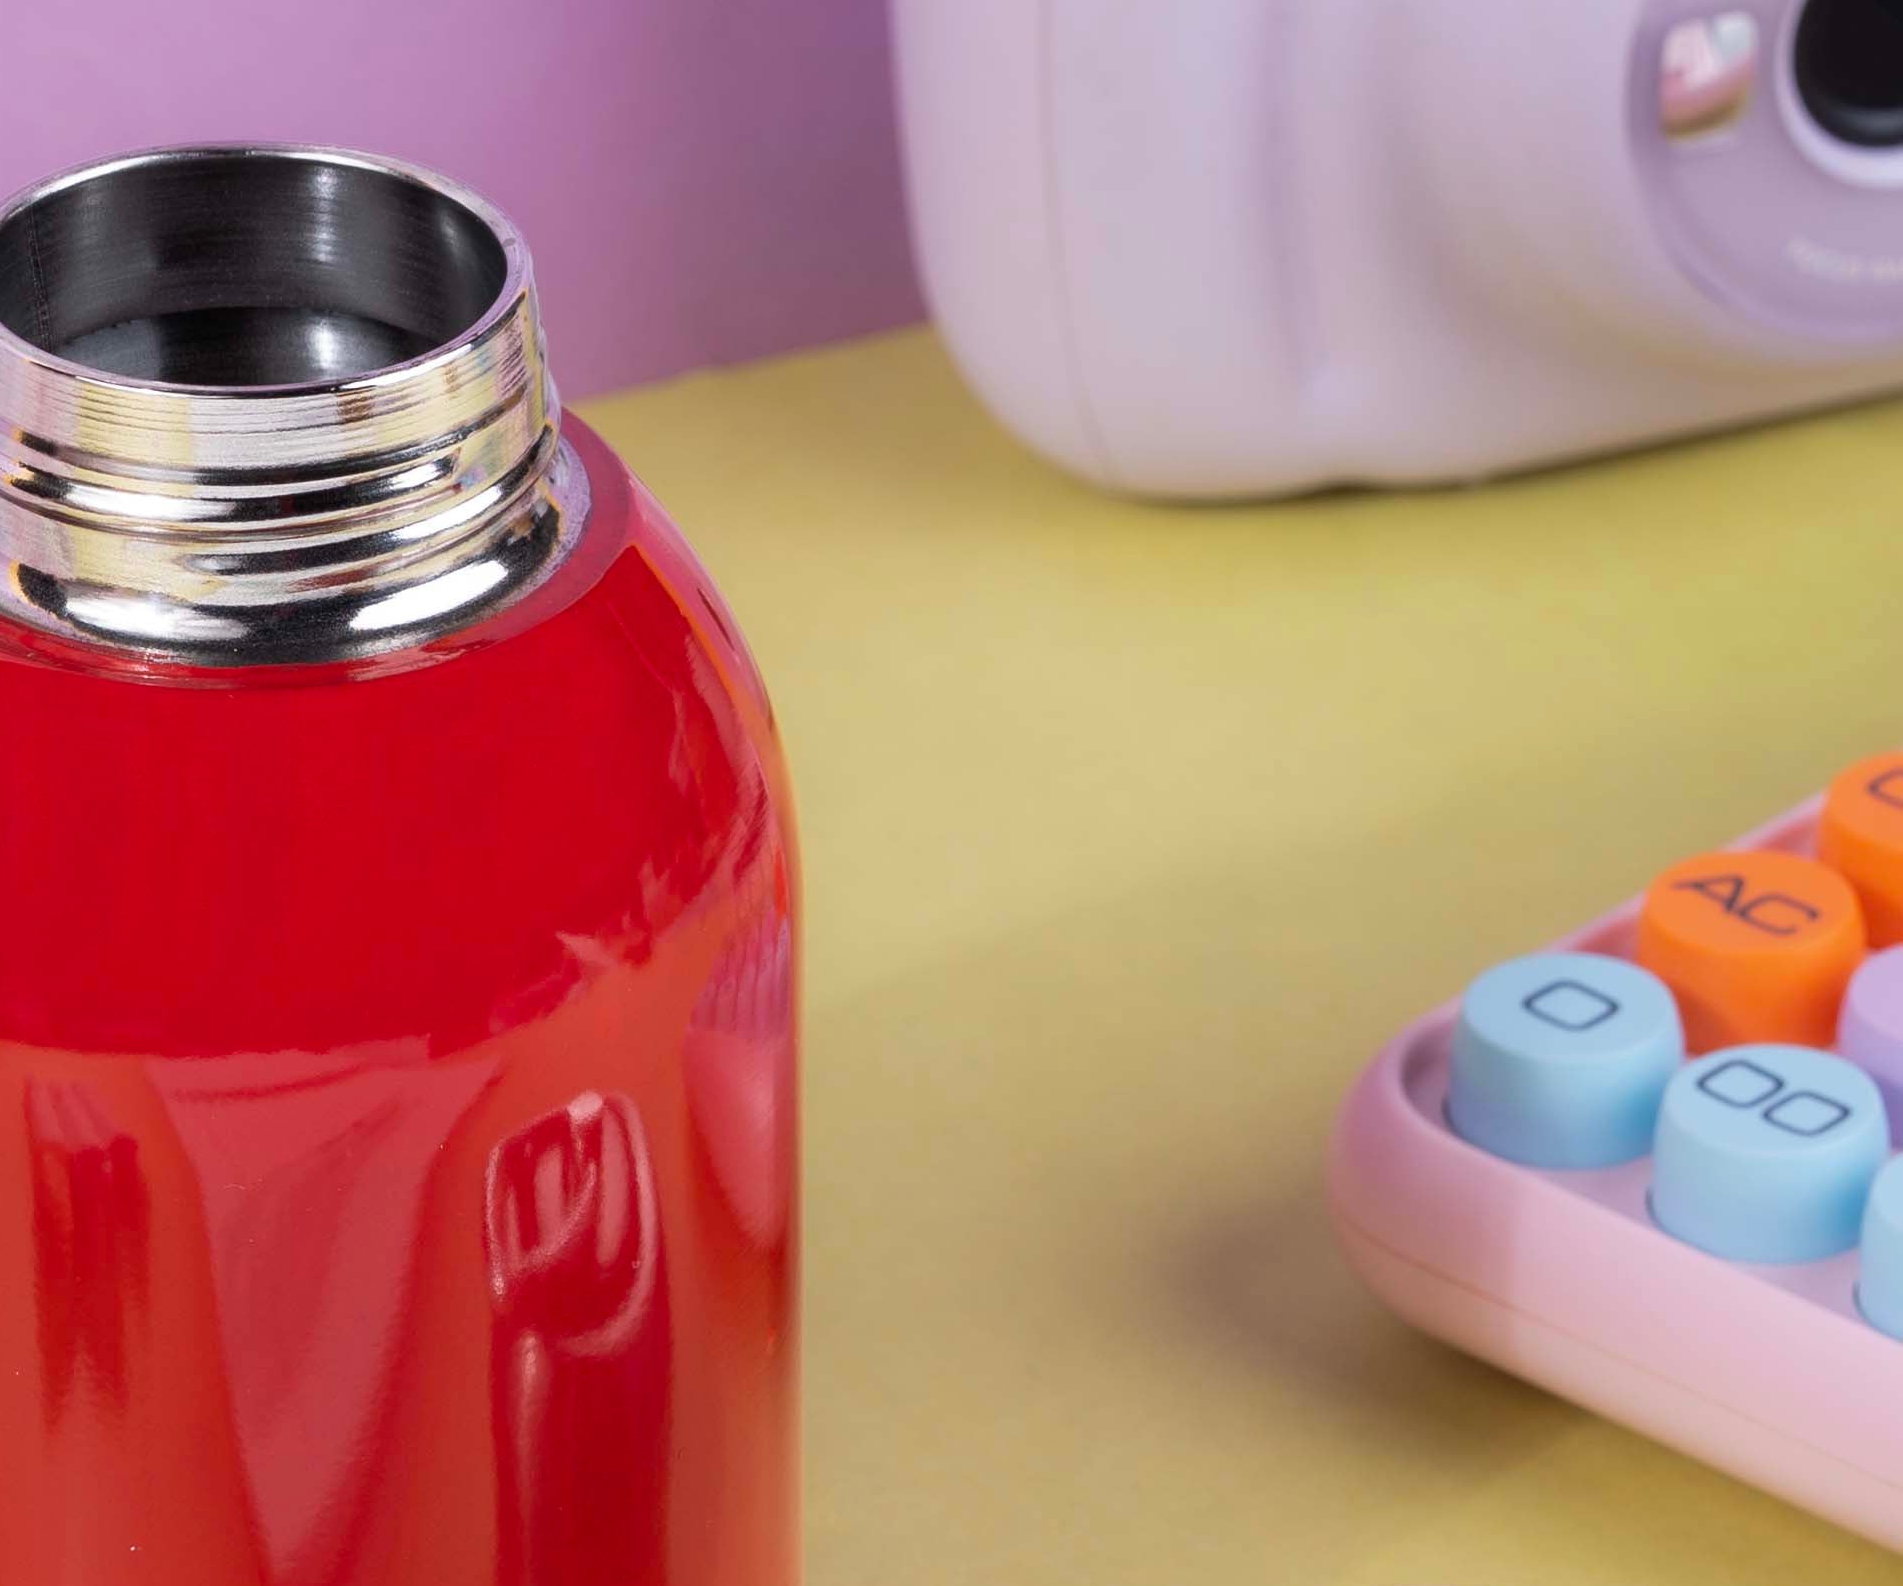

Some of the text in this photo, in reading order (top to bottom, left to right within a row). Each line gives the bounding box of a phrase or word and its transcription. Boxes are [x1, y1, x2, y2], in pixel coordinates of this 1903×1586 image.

[1670, 874, 1820, 936] AC
[1522, 979, 1620, 1031] 0
[1696, 1058, 1853, 1137] 00
